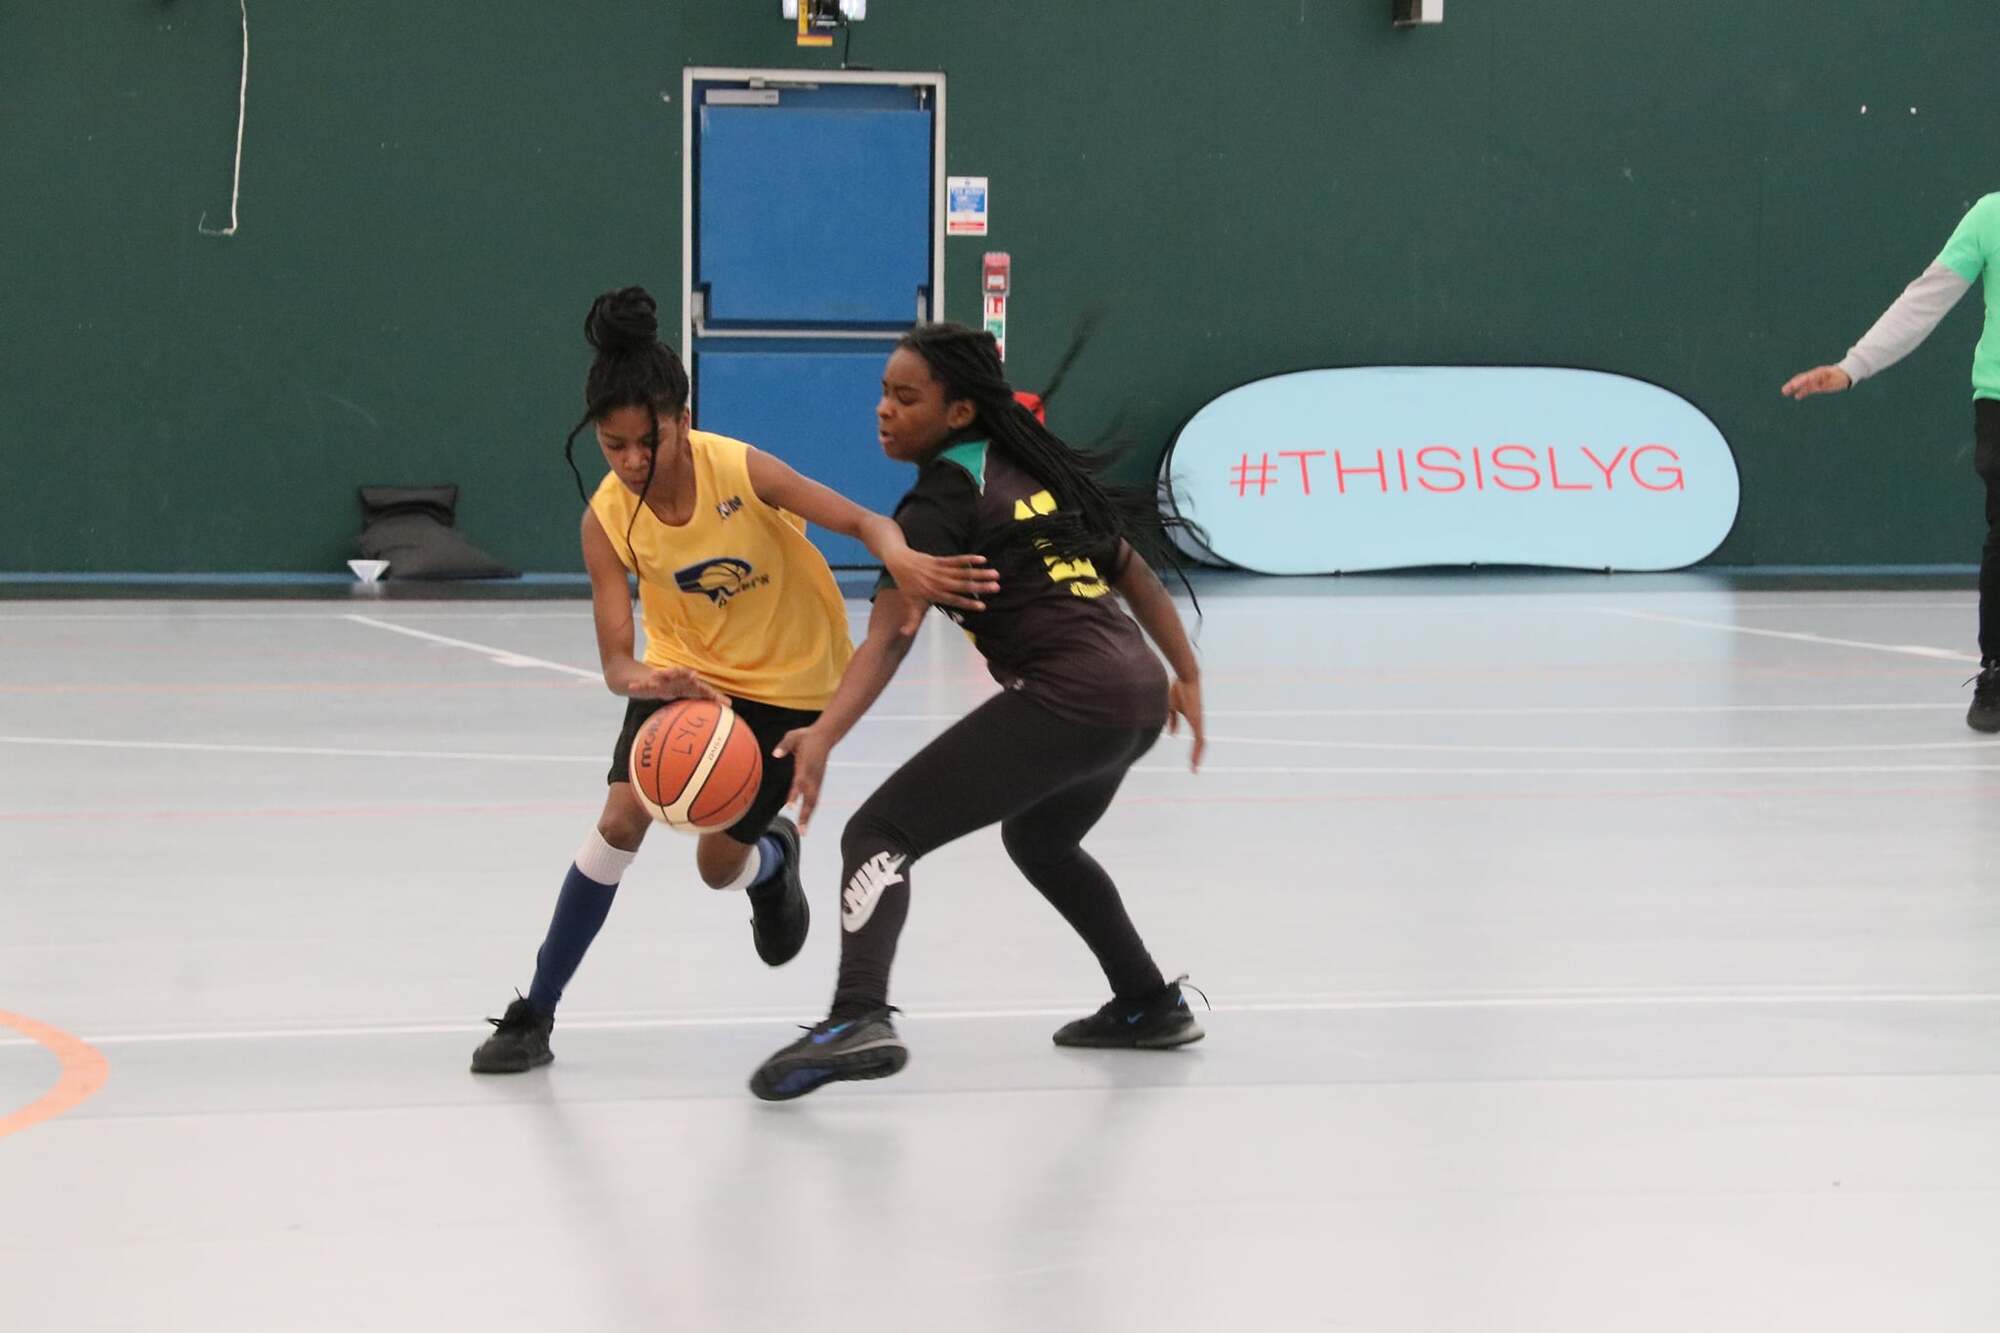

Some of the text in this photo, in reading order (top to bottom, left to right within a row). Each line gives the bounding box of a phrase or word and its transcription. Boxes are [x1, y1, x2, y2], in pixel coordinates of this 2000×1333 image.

[1230, 445, 1685, 496] #THISISLYG
[671, 717, 706, 755] LYG
[843, 850, 907, 915] NIKE
